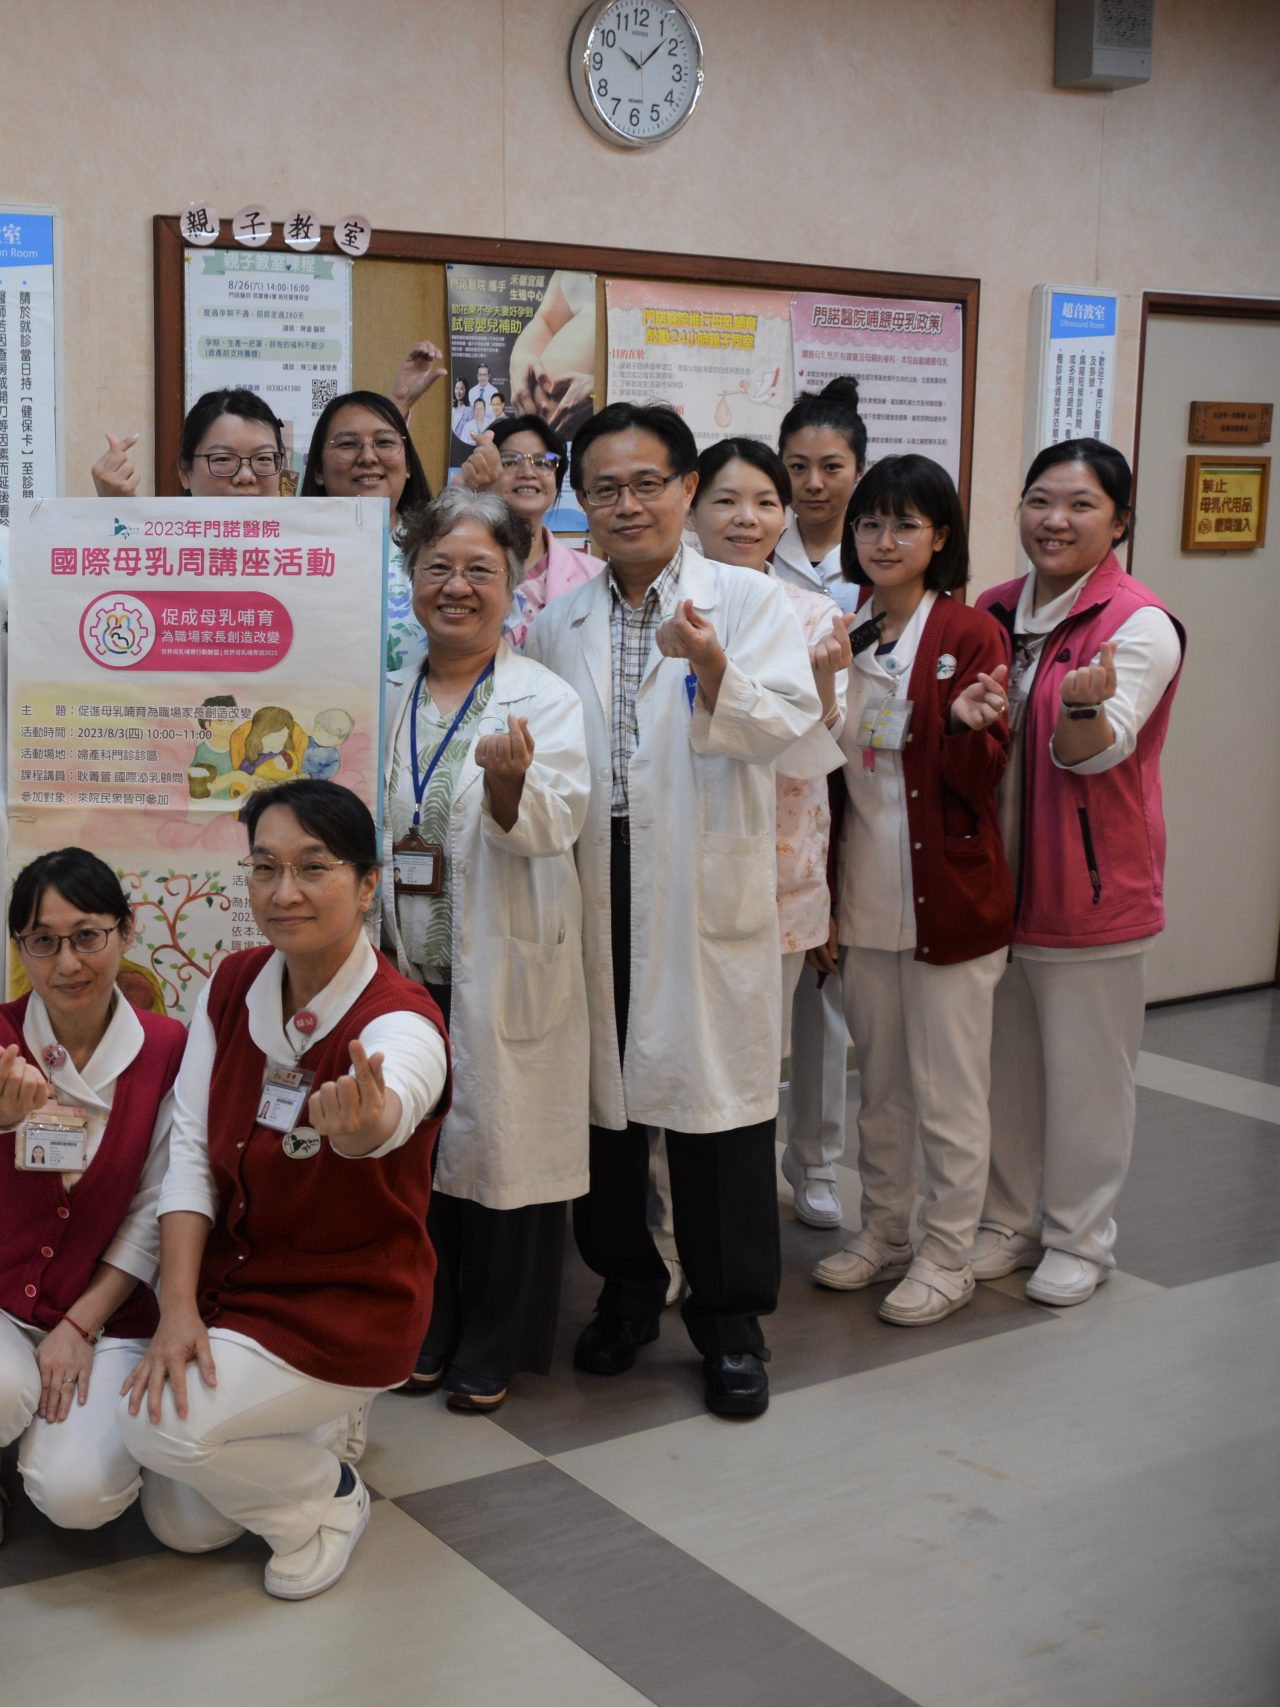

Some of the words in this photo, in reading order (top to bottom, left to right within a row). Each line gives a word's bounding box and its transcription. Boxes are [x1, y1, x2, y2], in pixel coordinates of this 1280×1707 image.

[616, 12, 629, 31] 11
[633, 8, 650, 27] 12
[659, 19, 665, 37] 1
[601, 29, 616, 48] 10
[667, 38, 679, 57] 2
[592, 52, 603, 71] 9
[672, 64, 683, 83] 3
[597, 78, 608, 97] 8
[611, 97, 622, 116] 7
[664, 89, 675, 107] 4
[629, 108, 640, 127] 6
[650, 104, 660, 122] 5
[186, 208, 365, 250] 親子教室
[10, 248, 38, 258] Room
[228, 280, 264, 292] 8/26(六)
[266, 282, 310, 292] 14:00-16:00
[1062, 301, 1105, 321] 超音波室
[1201, 478, 1228, 494] 禁止
[144, 520, 281, 539] 2023年門諾醫院
[50, 547, 336, 577] 國際母乳周講座活動
[161, 608, 274, 627] 促成母乳哺育
[161, 630, 281, 645] 為職場家長創造改變
[146, 729, 213, 741] 10:00~11:00
[231, 912, 255, 922] 202
